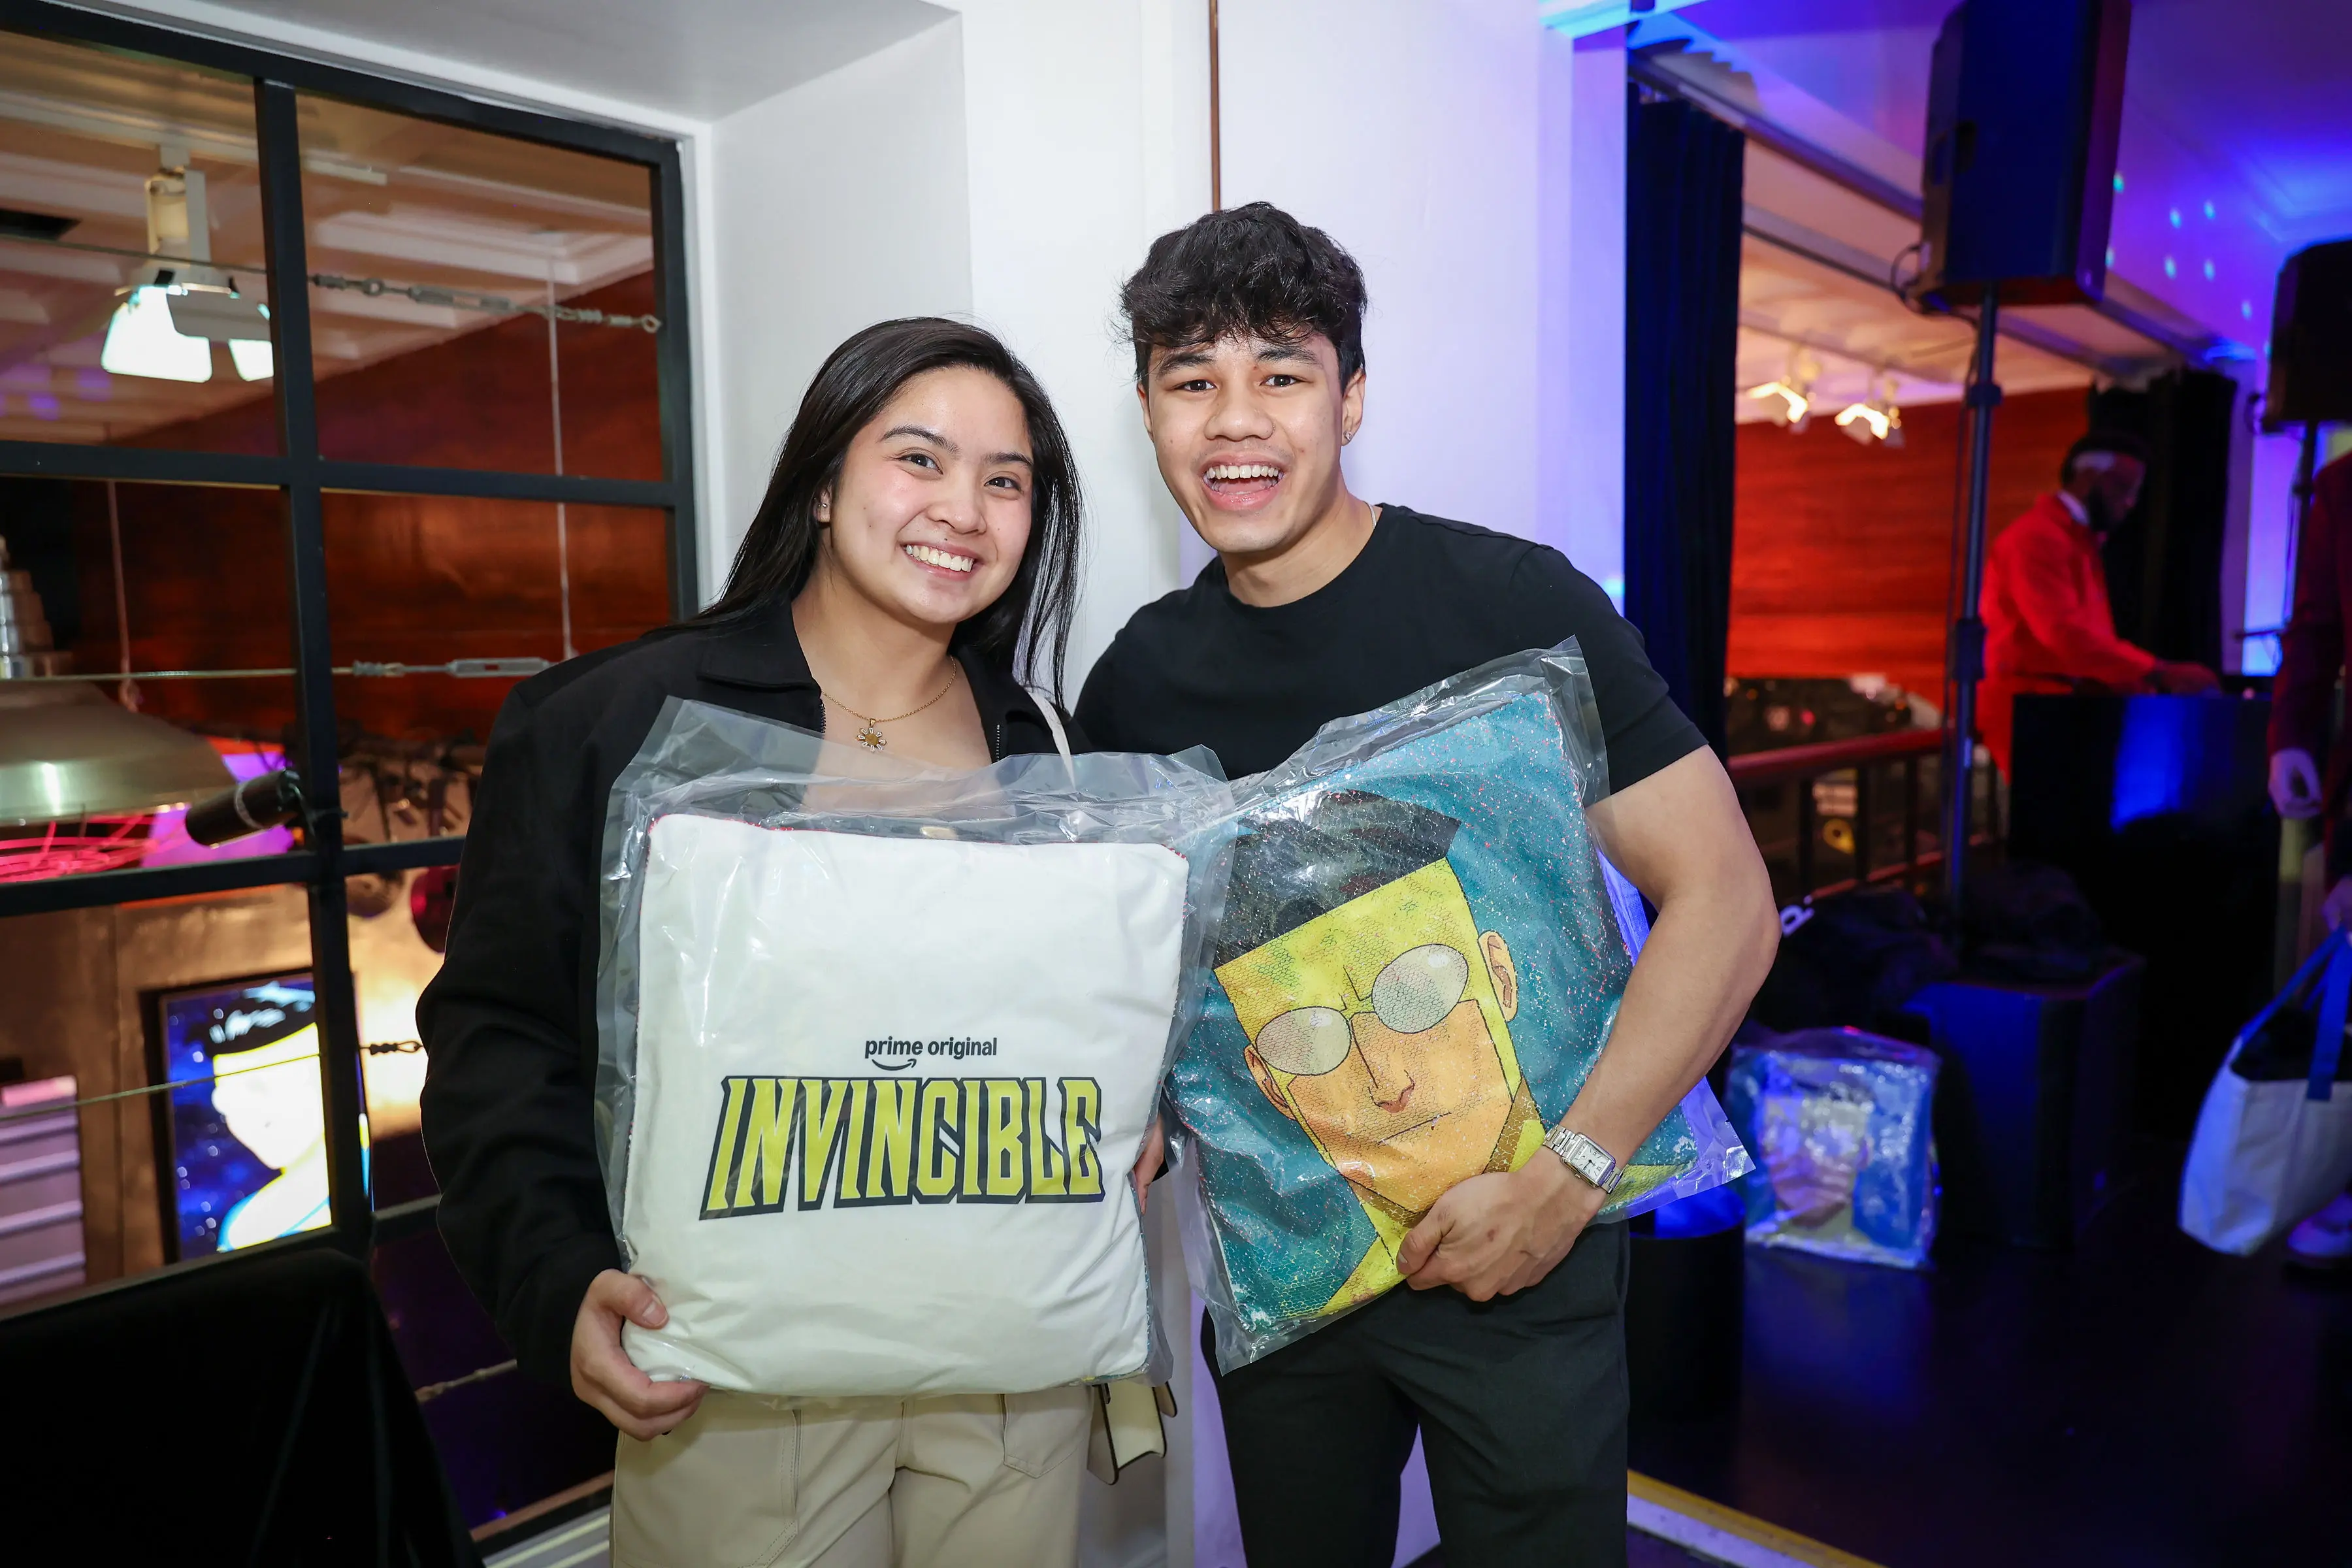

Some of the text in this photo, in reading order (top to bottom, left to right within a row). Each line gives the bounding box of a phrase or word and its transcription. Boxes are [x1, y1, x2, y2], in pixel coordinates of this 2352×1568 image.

[864, 1036, 997, 1060] prime original
[699, 1075, 1105, 1220] INVINCIBLE
